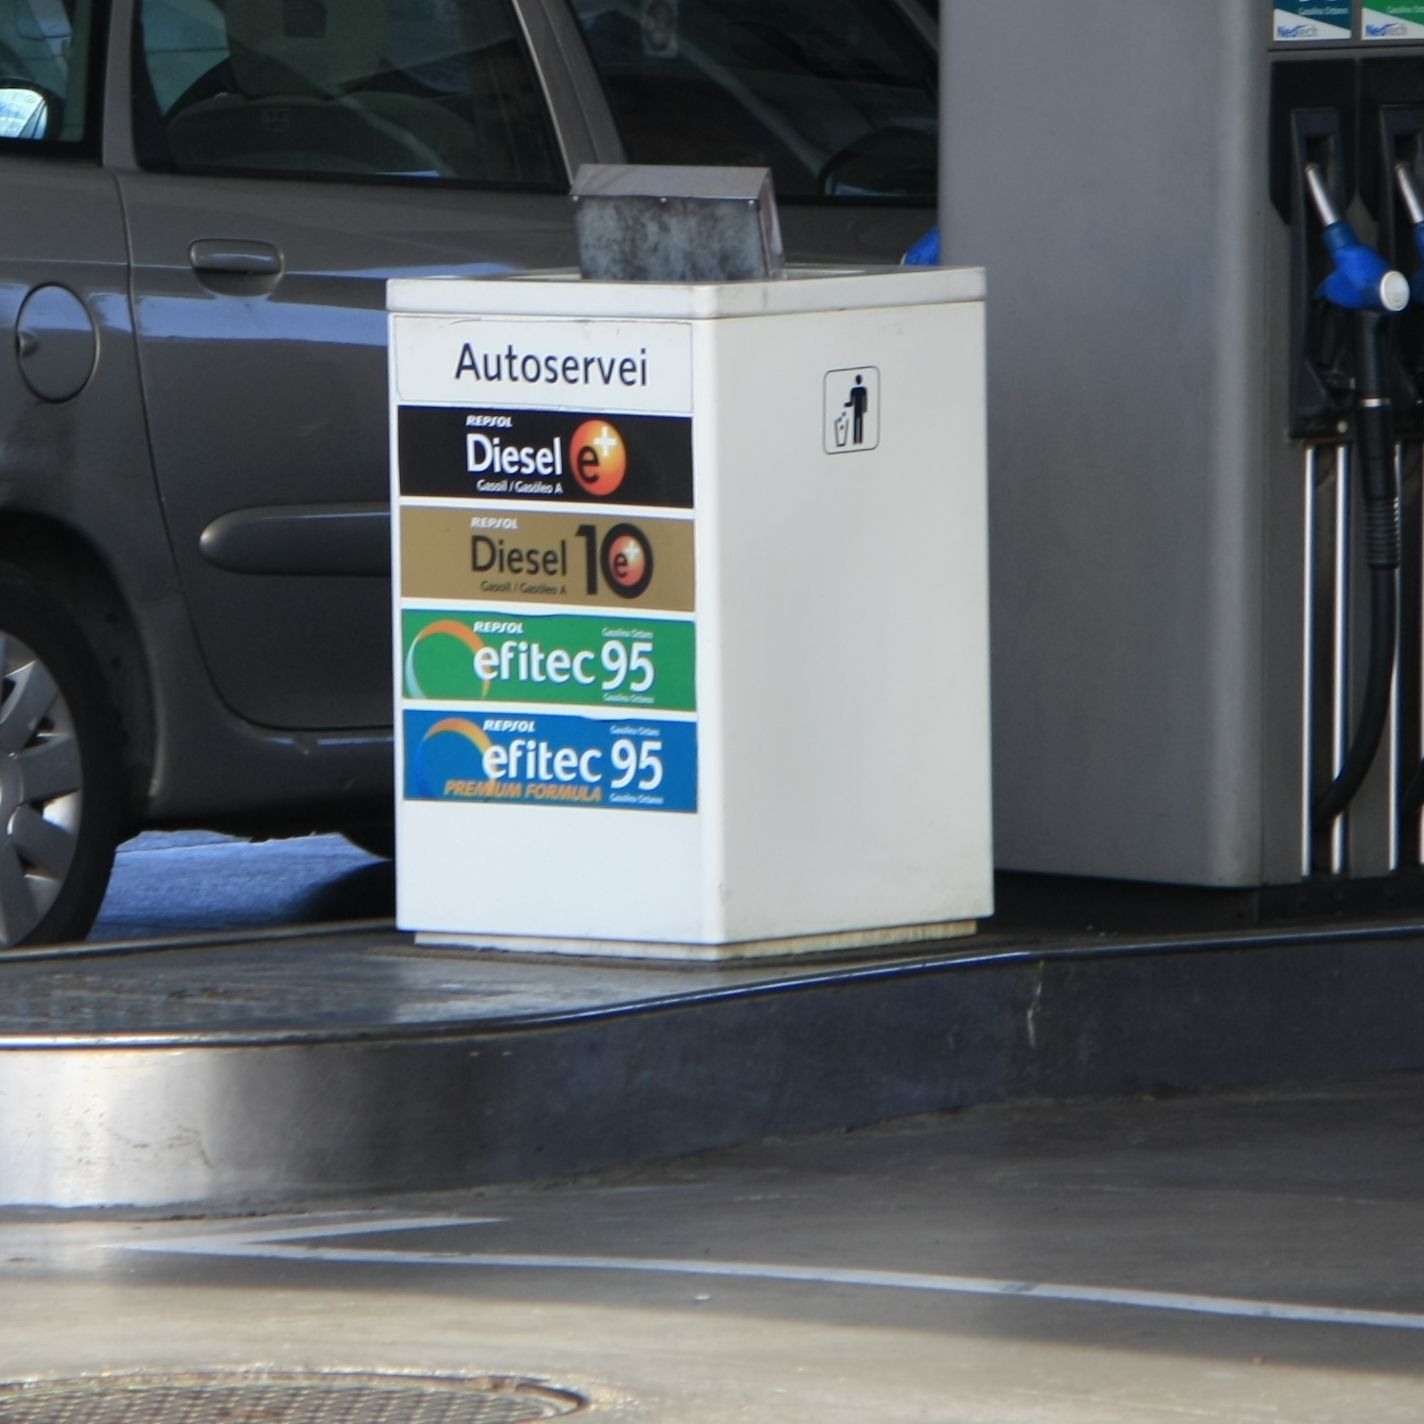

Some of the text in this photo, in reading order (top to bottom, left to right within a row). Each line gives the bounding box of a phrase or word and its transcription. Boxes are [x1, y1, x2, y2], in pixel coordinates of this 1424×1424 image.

[455, 342, 648, 386] Autoservei
[465, 415, 513, 428] REPSOL
[466, 433, 563, 476] Diesel
[470, 516, 519, 529] REPSOL
[471, 534, 567, 577] Diesel
[473, 621, 524, 634] REPSOL
[473, 639, 655, 693] efitec 95
[482, 719, 536, 733] REPSOL
[481, 739, 664, 791] efitec 95
[444, 780, 602, 802] PREMIUM FORMULA
